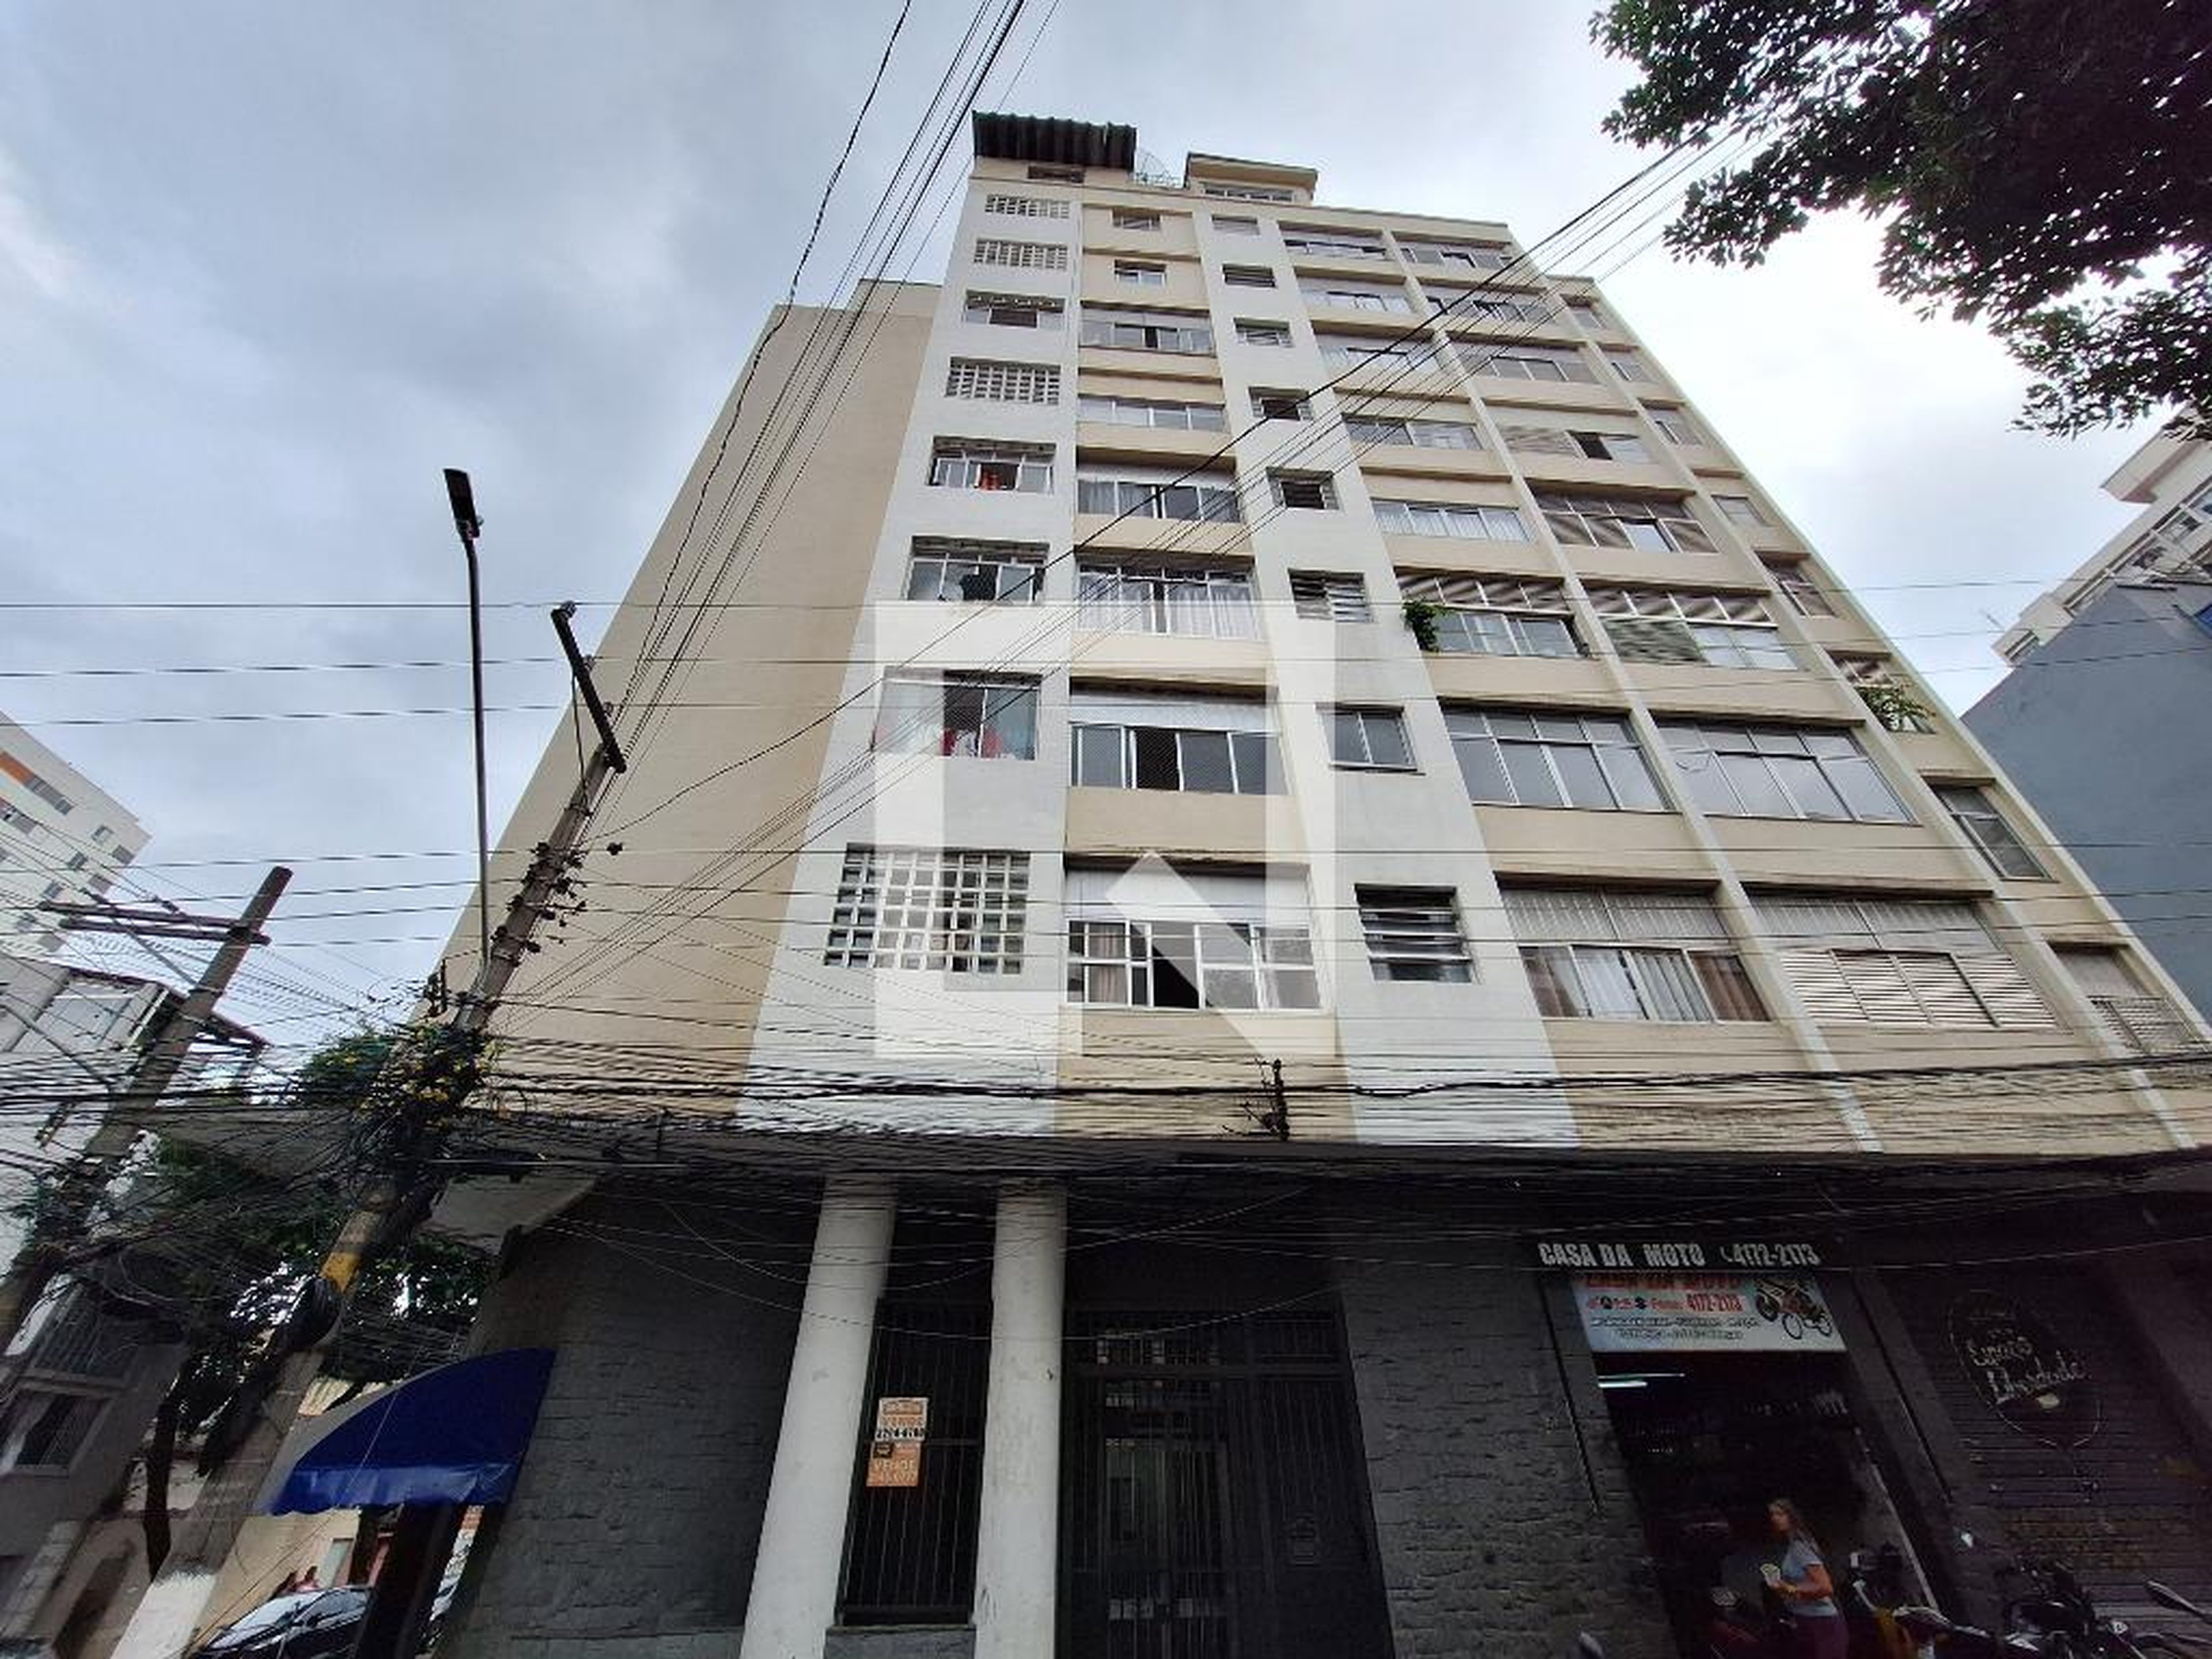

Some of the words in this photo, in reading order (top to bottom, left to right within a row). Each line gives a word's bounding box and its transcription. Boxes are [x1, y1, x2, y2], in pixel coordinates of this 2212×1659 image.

[1539, 1243, 1597, 1266] CASA
[1599, 1244, 1634, 1266] DA
[1643, 1244, 1706, 1266] MOTO
